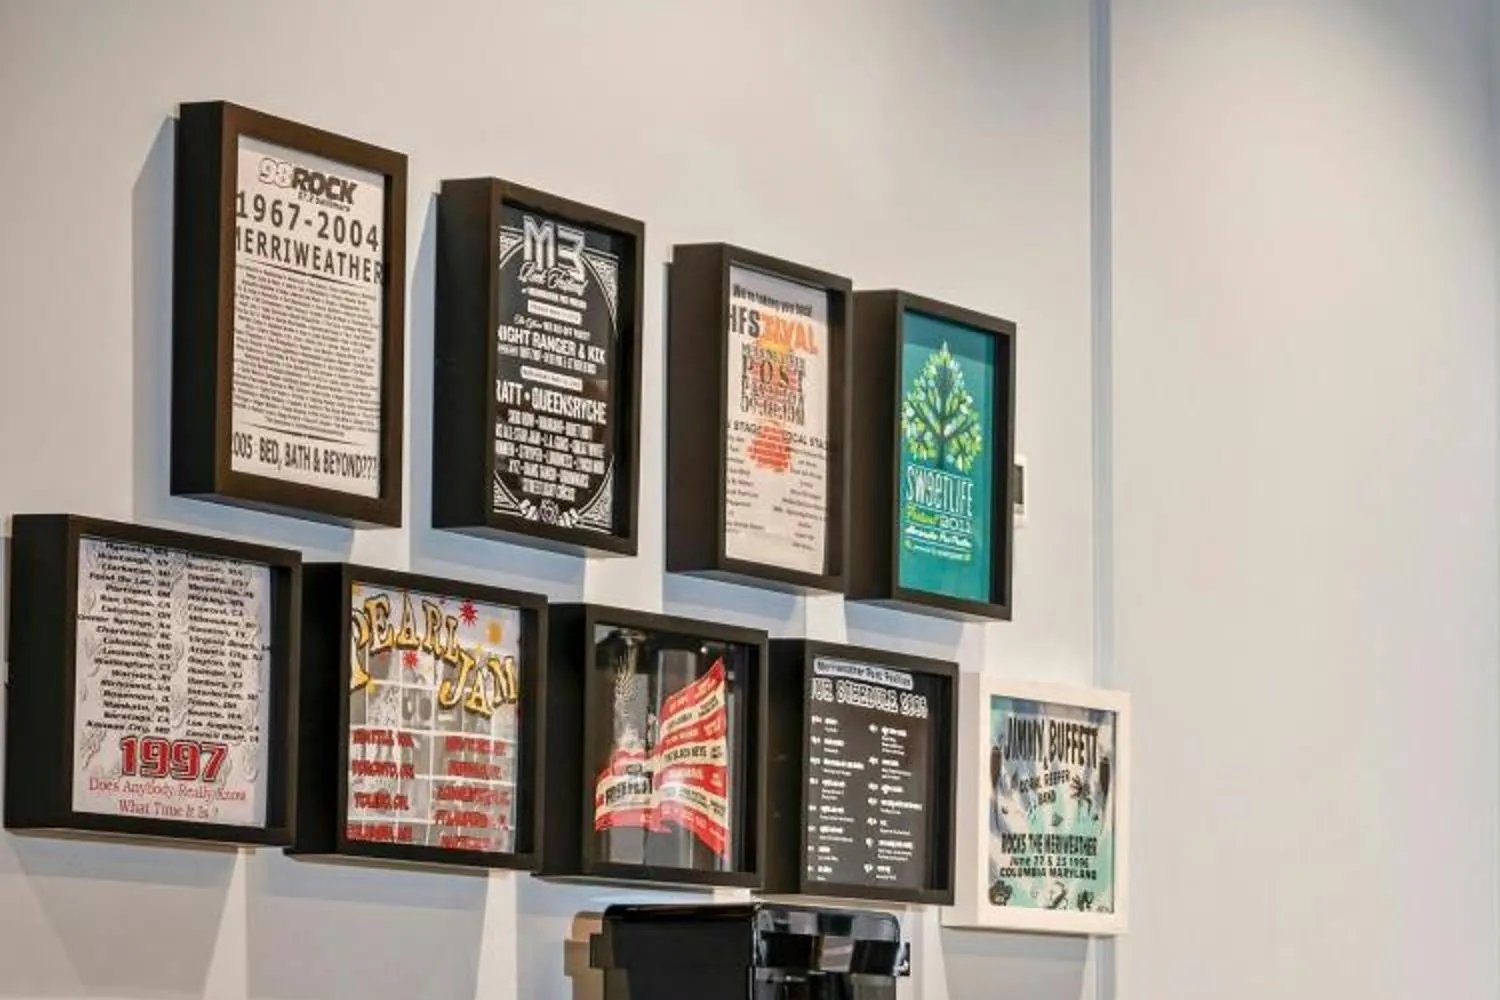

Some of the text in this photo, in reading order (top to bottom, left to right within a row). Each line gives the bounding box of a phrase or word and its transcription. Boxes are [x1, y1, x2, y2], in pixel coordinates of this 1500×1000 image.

[236, 190, 379, 252] 1967-2004
[532, 330, 576, 357] RANGER
[284, 442, 311, 471] BATH
[1004, 717, 1099, 769] JIMMY BUFFETT
[120, 735, 229, 783] 1997
[88, 776, 120, 792] Does
[119, 799, 150, 814] What
[154, 802, 181, 816] Time
